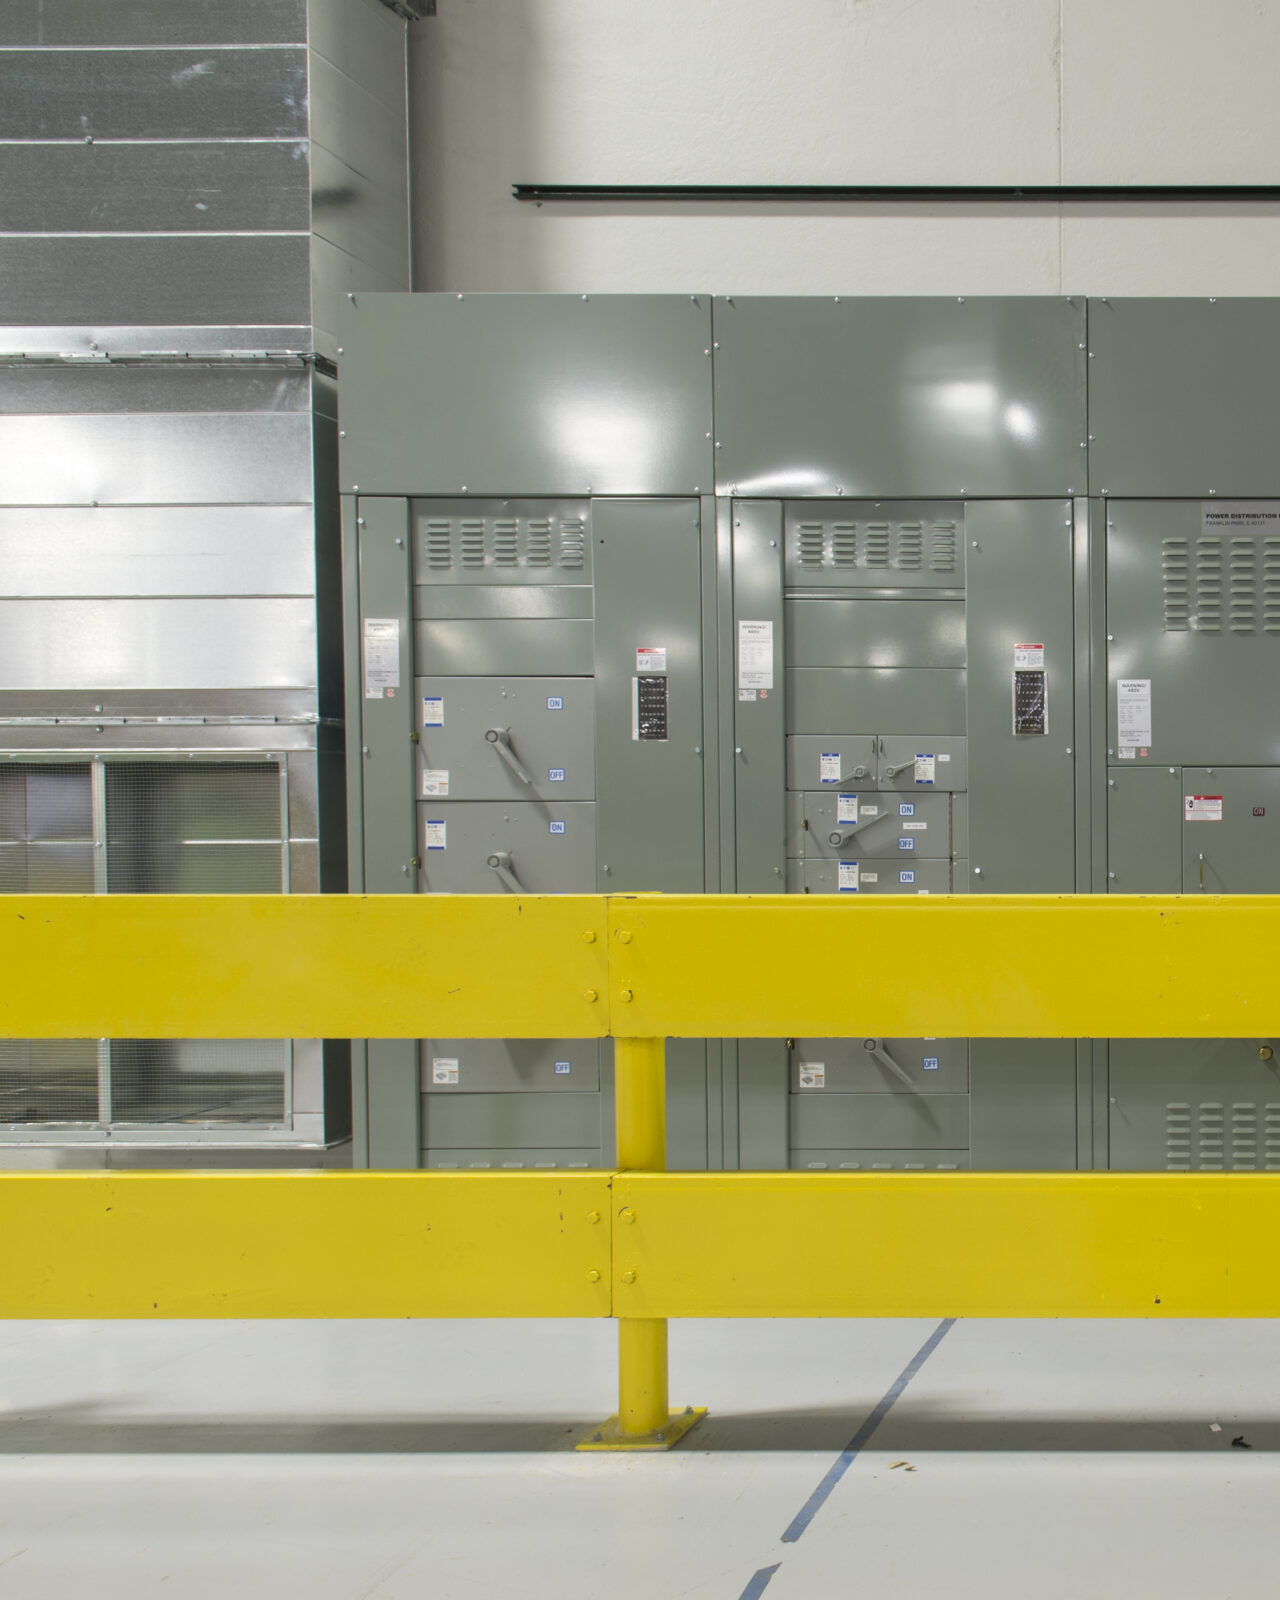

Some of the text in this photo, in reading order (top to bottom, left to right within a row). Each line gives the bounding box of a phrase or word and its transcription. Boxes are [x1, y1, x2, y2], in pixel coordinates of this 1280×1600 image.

[549, 699, 560, 707] ON
[550, 771, 563, 779] OFF
[901, 806, 912, 814] ON
[1254, 807, 1264, 815] ON
[552, 823, 562, 831] ON
[899, 840, 912, 848] OFF
[902, 873, 912, 881] ON
[556, 1064, 568, 1072] OFF
[924, 1060, 937, 1068] OFF
